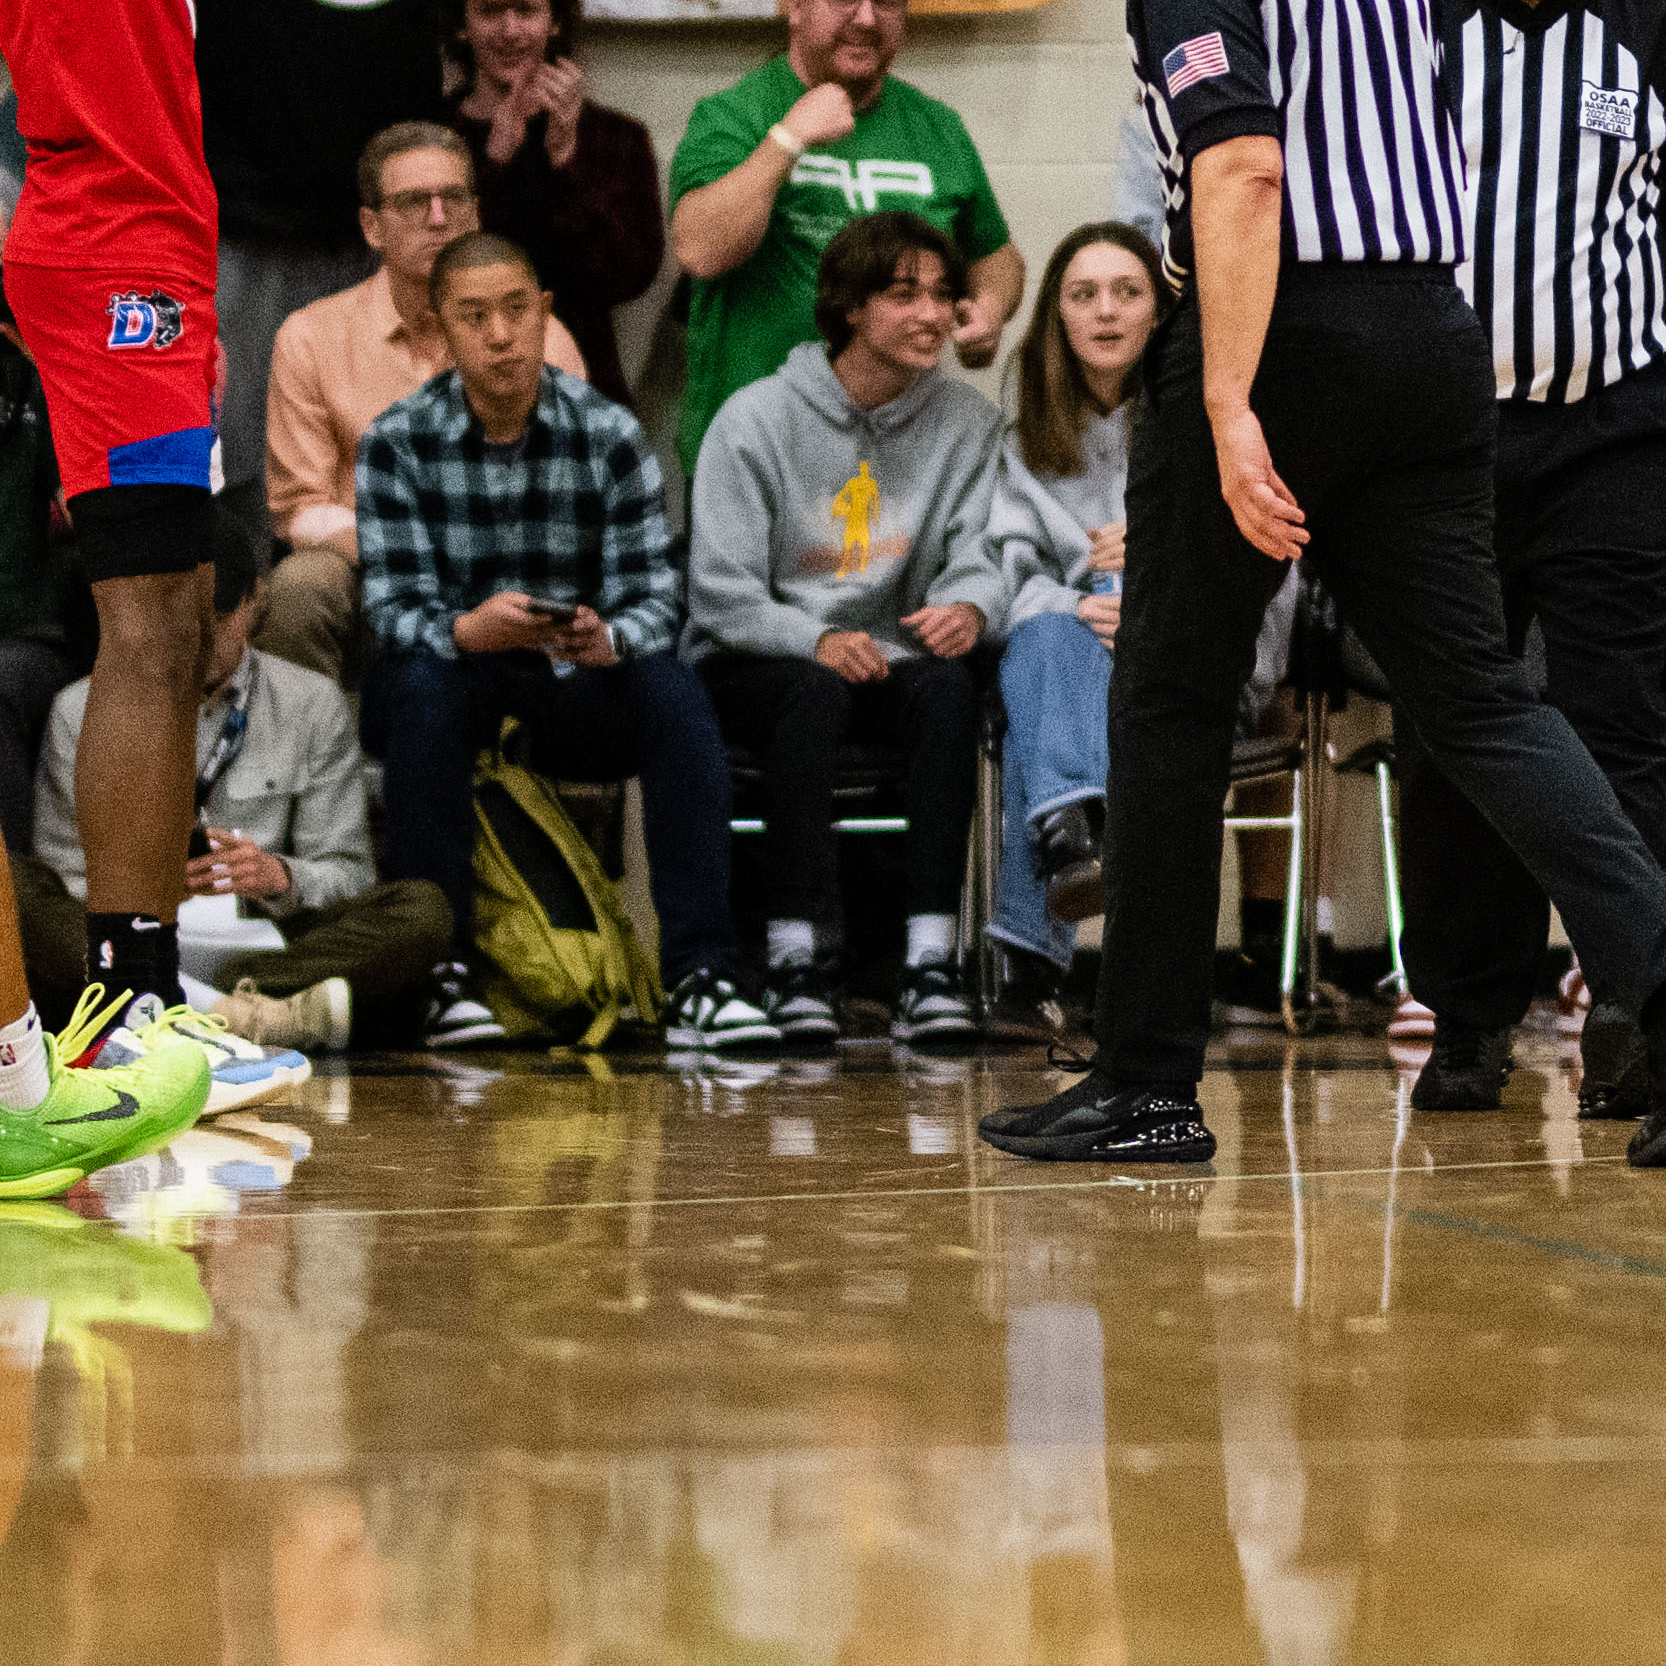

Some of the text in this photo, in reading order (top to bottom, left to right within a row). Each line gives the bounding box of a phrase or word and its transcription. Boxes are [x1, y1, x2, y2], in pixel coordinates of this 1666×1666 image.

[1590, 91, 1630, 108] OSAA
[1585, 101, 1632, 117] BASKETBALL
[107, 300, 157, 349] D
